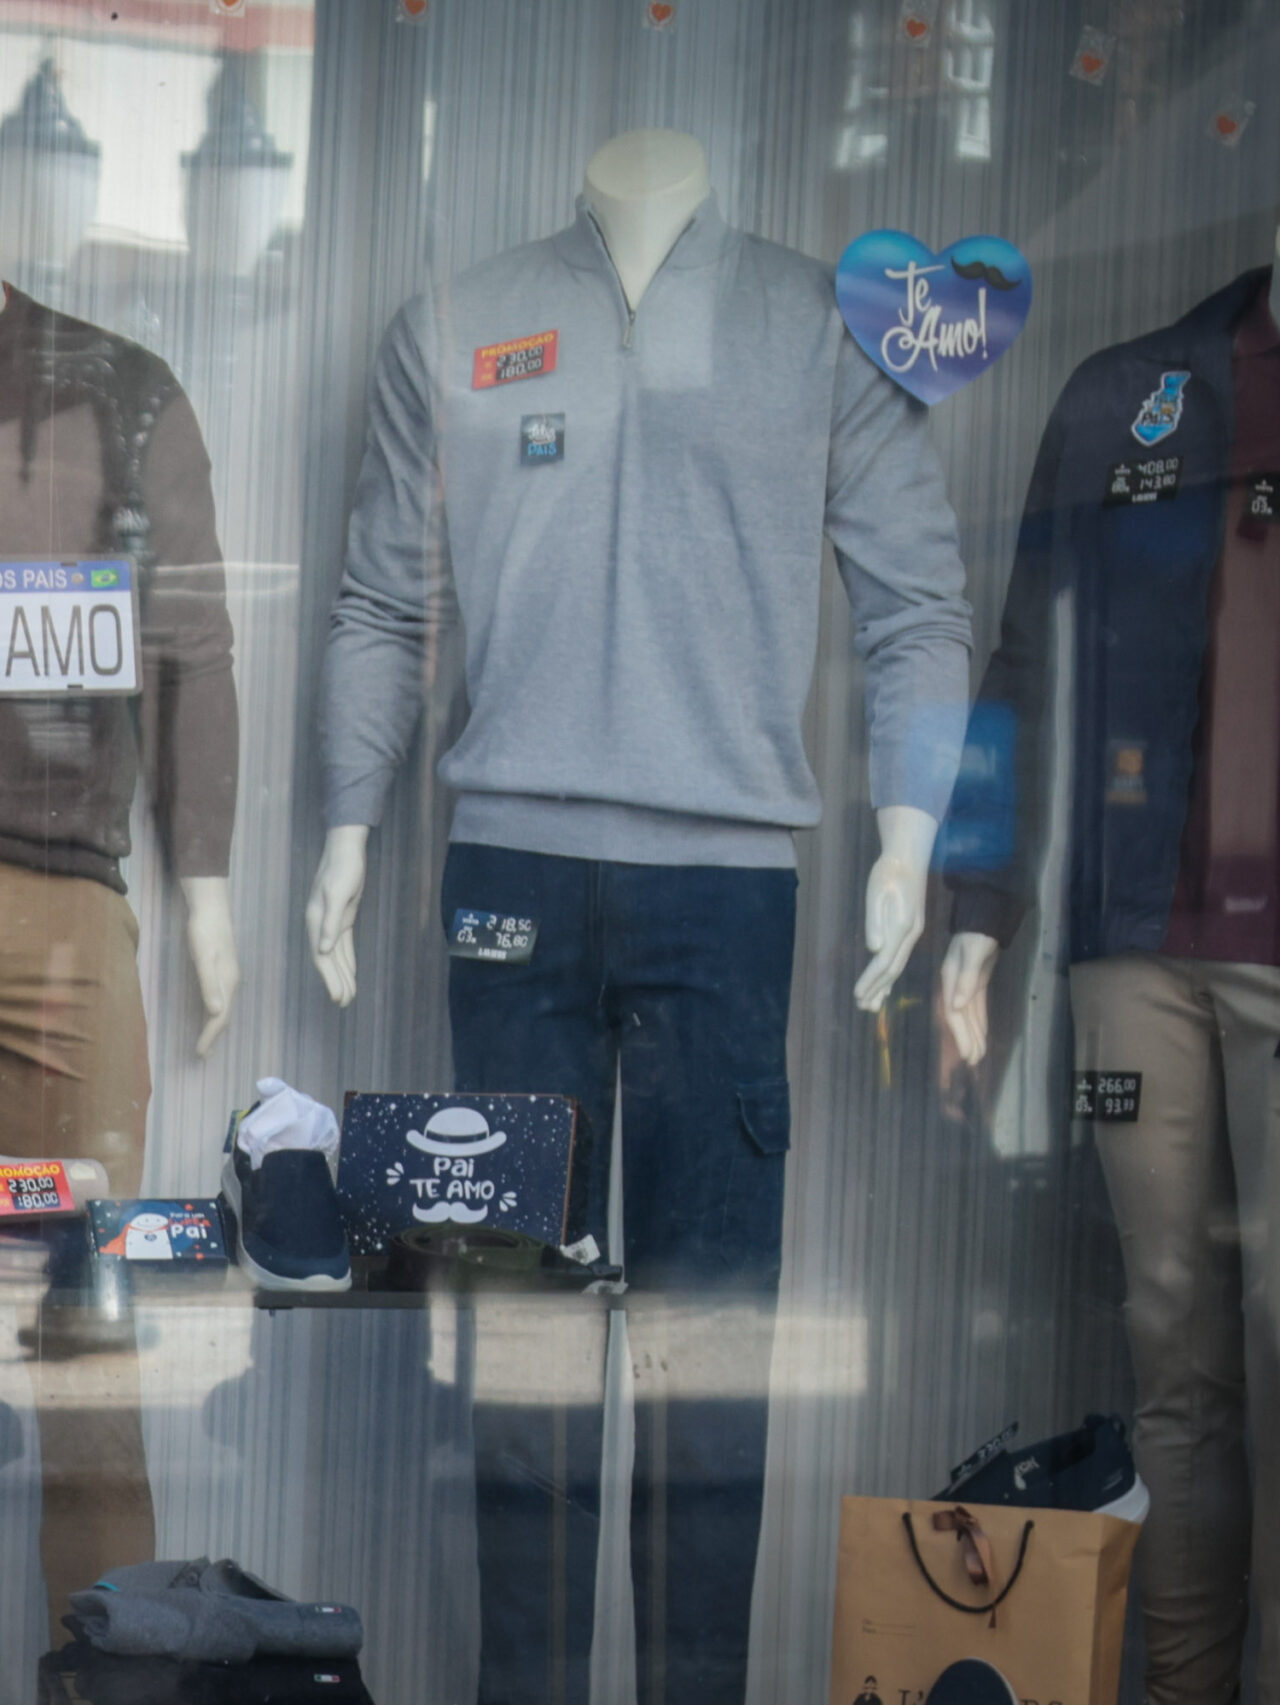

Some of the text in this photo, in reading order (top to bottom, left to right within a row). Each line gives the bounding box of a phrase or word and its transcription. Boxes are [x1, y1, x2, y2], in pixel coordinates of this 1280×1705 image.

[884, 261, 946, 328] Te
[881, 287, 988, 373] Amo!
[22, 568, 68, 589] PAIS
[5, 603, 124, 678] AMO
[433, 1156, 475, 1178] Pai
[8, 1176, 55, 1194] 230,00
[409, 1178, 495, 1200] TE AMO
[17, 1192, 59, 1210] 180,00
[170, 1223, 208, 1240] Pai
